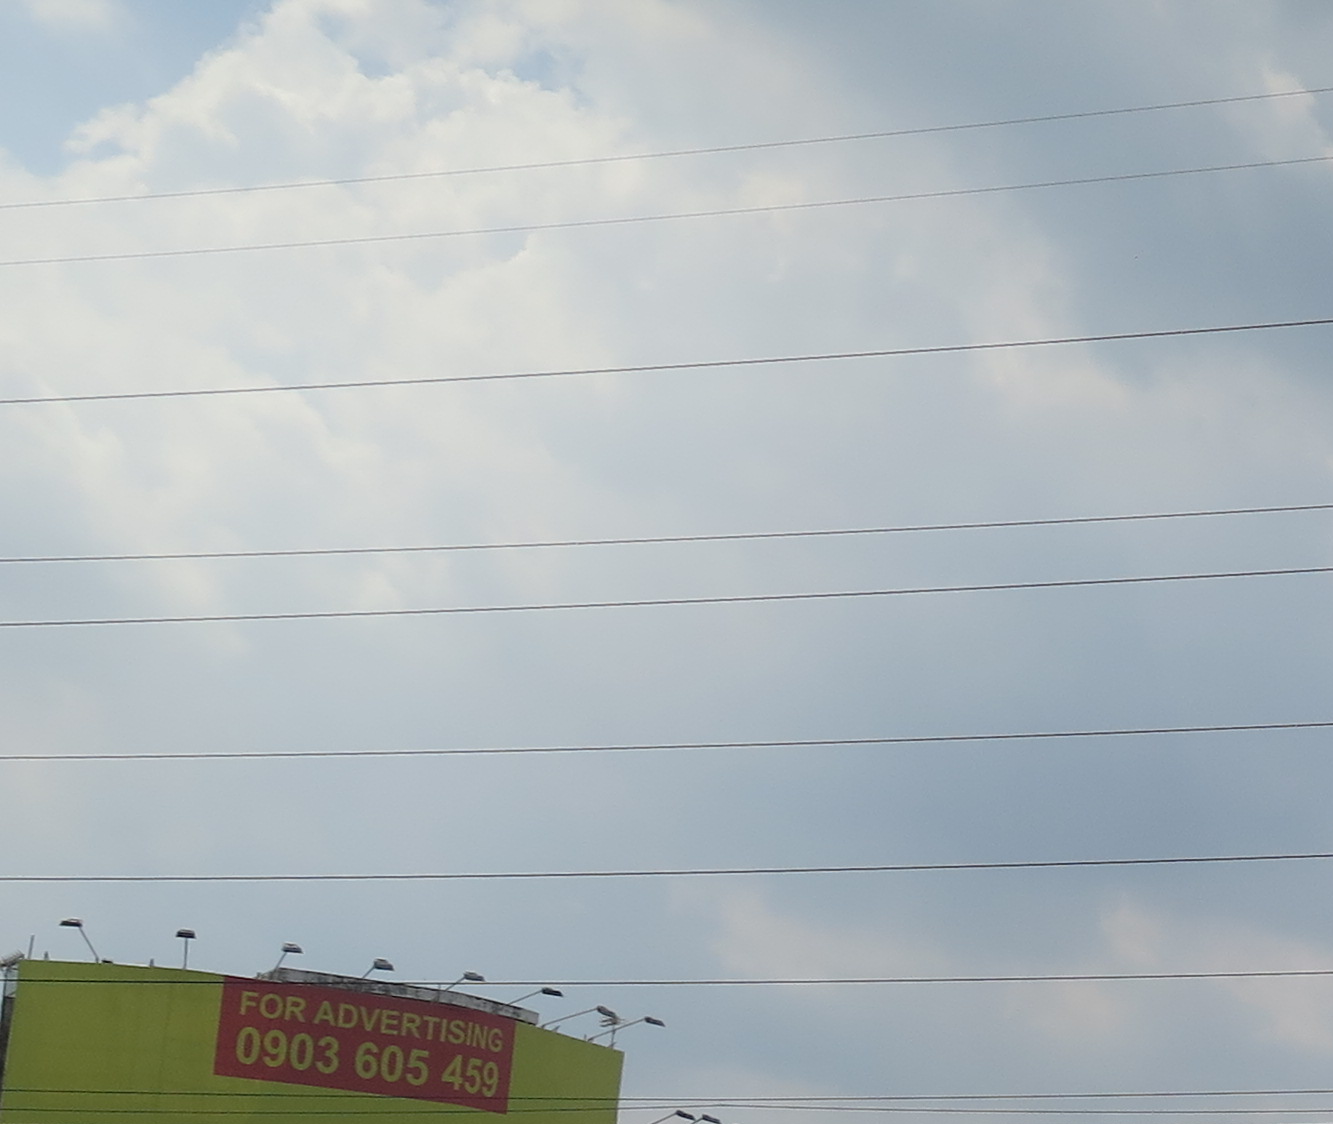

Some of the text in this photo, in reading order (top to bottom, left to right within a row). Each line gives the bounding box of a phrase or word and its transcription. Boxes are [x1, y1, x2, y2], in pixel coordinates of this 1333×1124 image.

[239, 991, 504, 1053] FOR ADVERTISING
[236, 1027, 500, 1098] 0903 605 459
